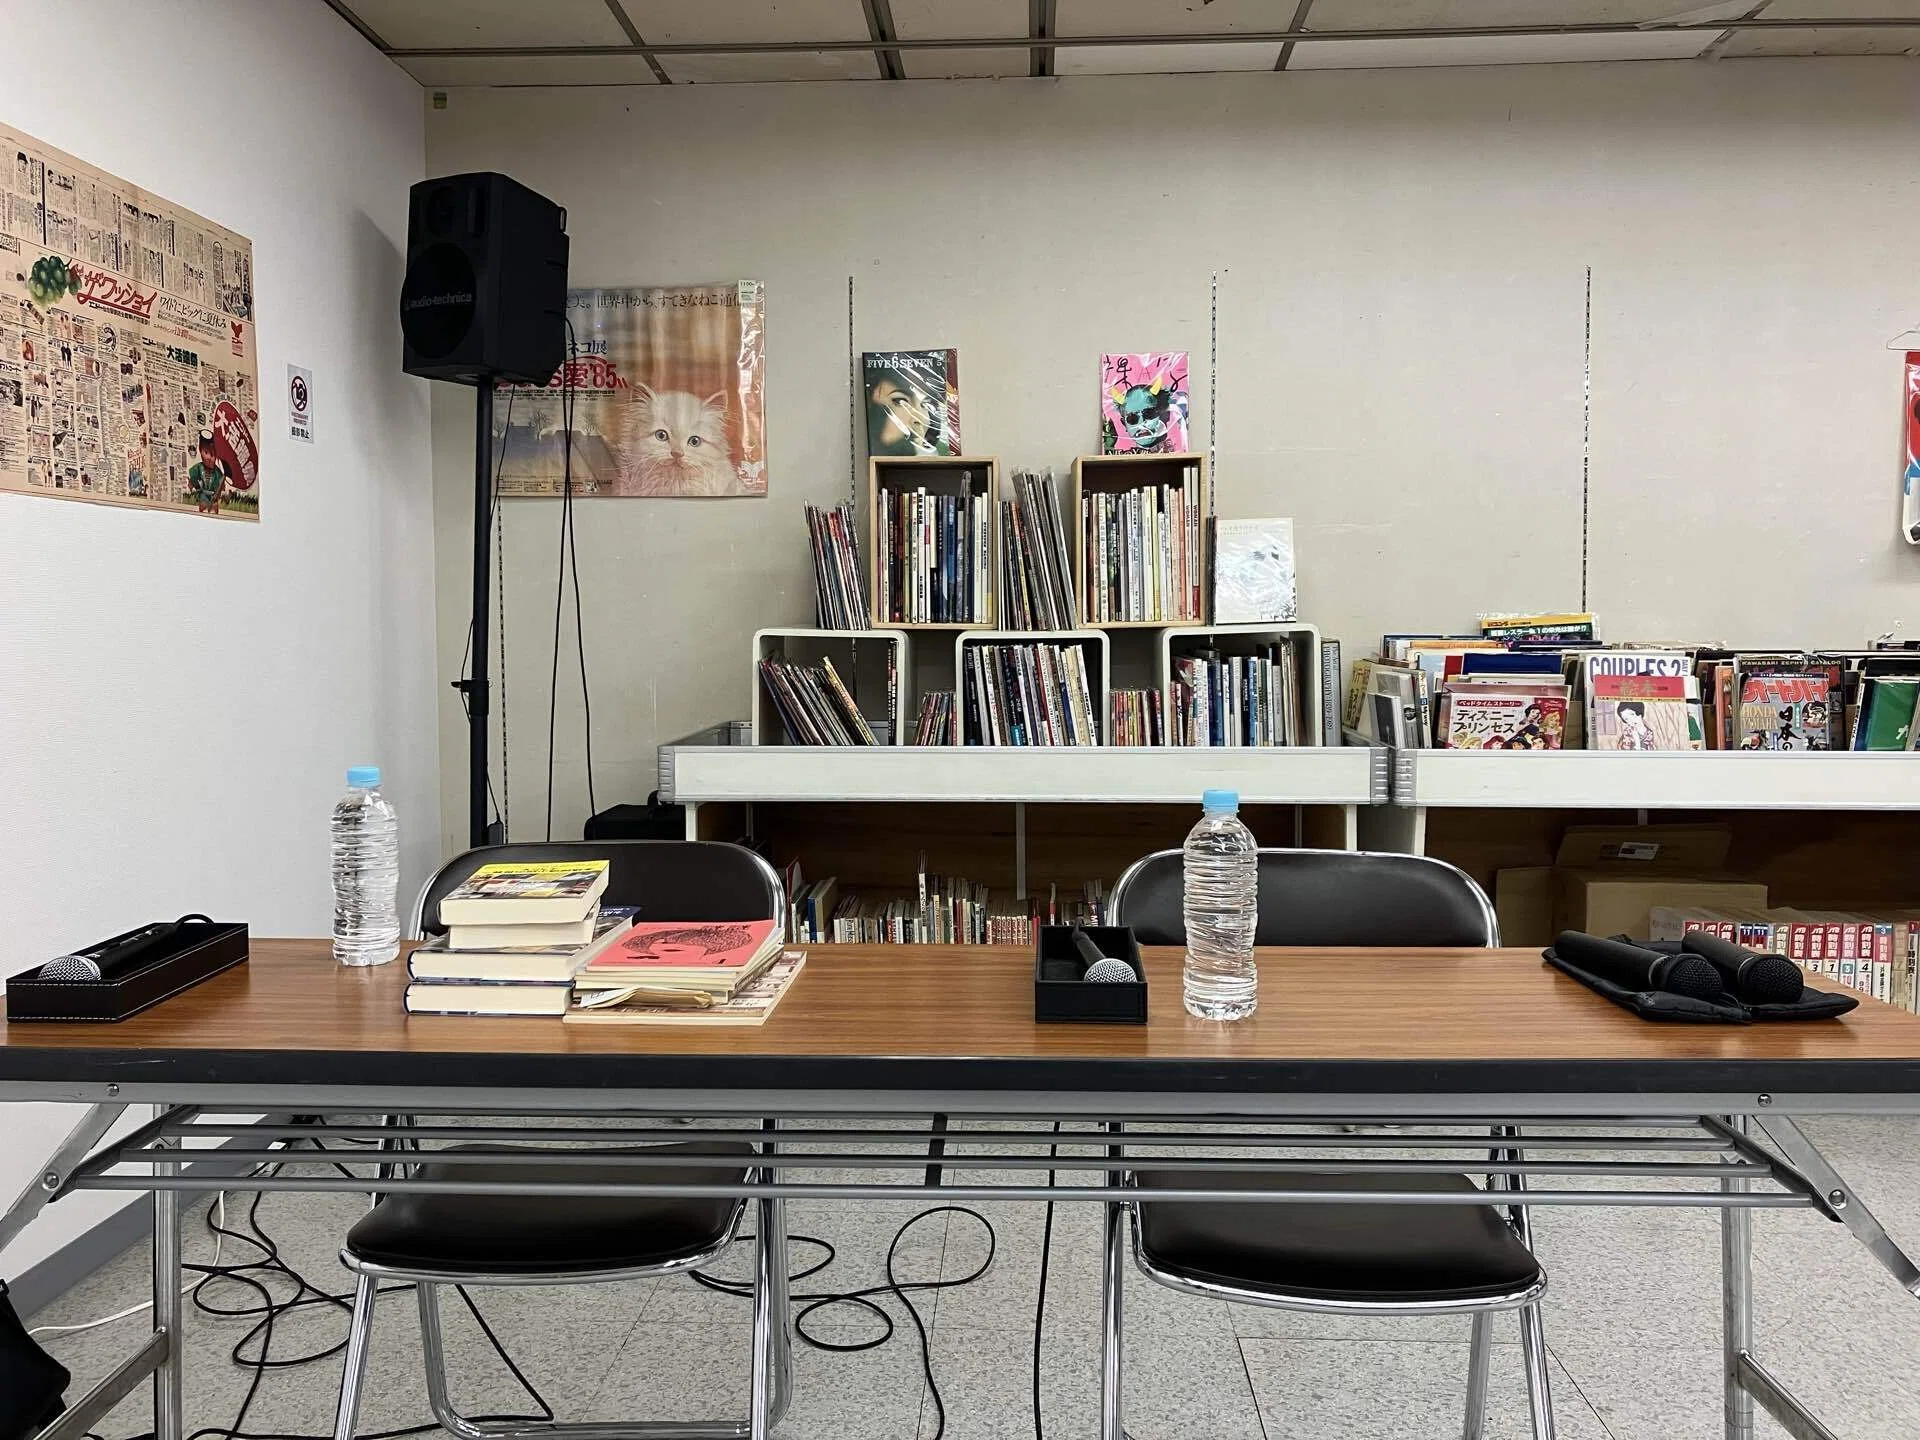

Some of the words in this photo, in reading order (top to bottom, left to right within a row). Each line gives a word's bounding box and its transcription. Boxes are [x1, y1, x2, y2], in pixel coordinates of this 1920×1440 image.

[411, 291, 473, 307] audio-technica
[1742, 679, 1830, 703] オートバイ
[1742, 705, 1777, 718] HONDA
[1453, 722, 1515, 734] プリンセス
[1743, 717, 1778, 730] YAMAHA
[1811, 964, 1819, 972] 3
[1861, 963, 1869, 972] 4
